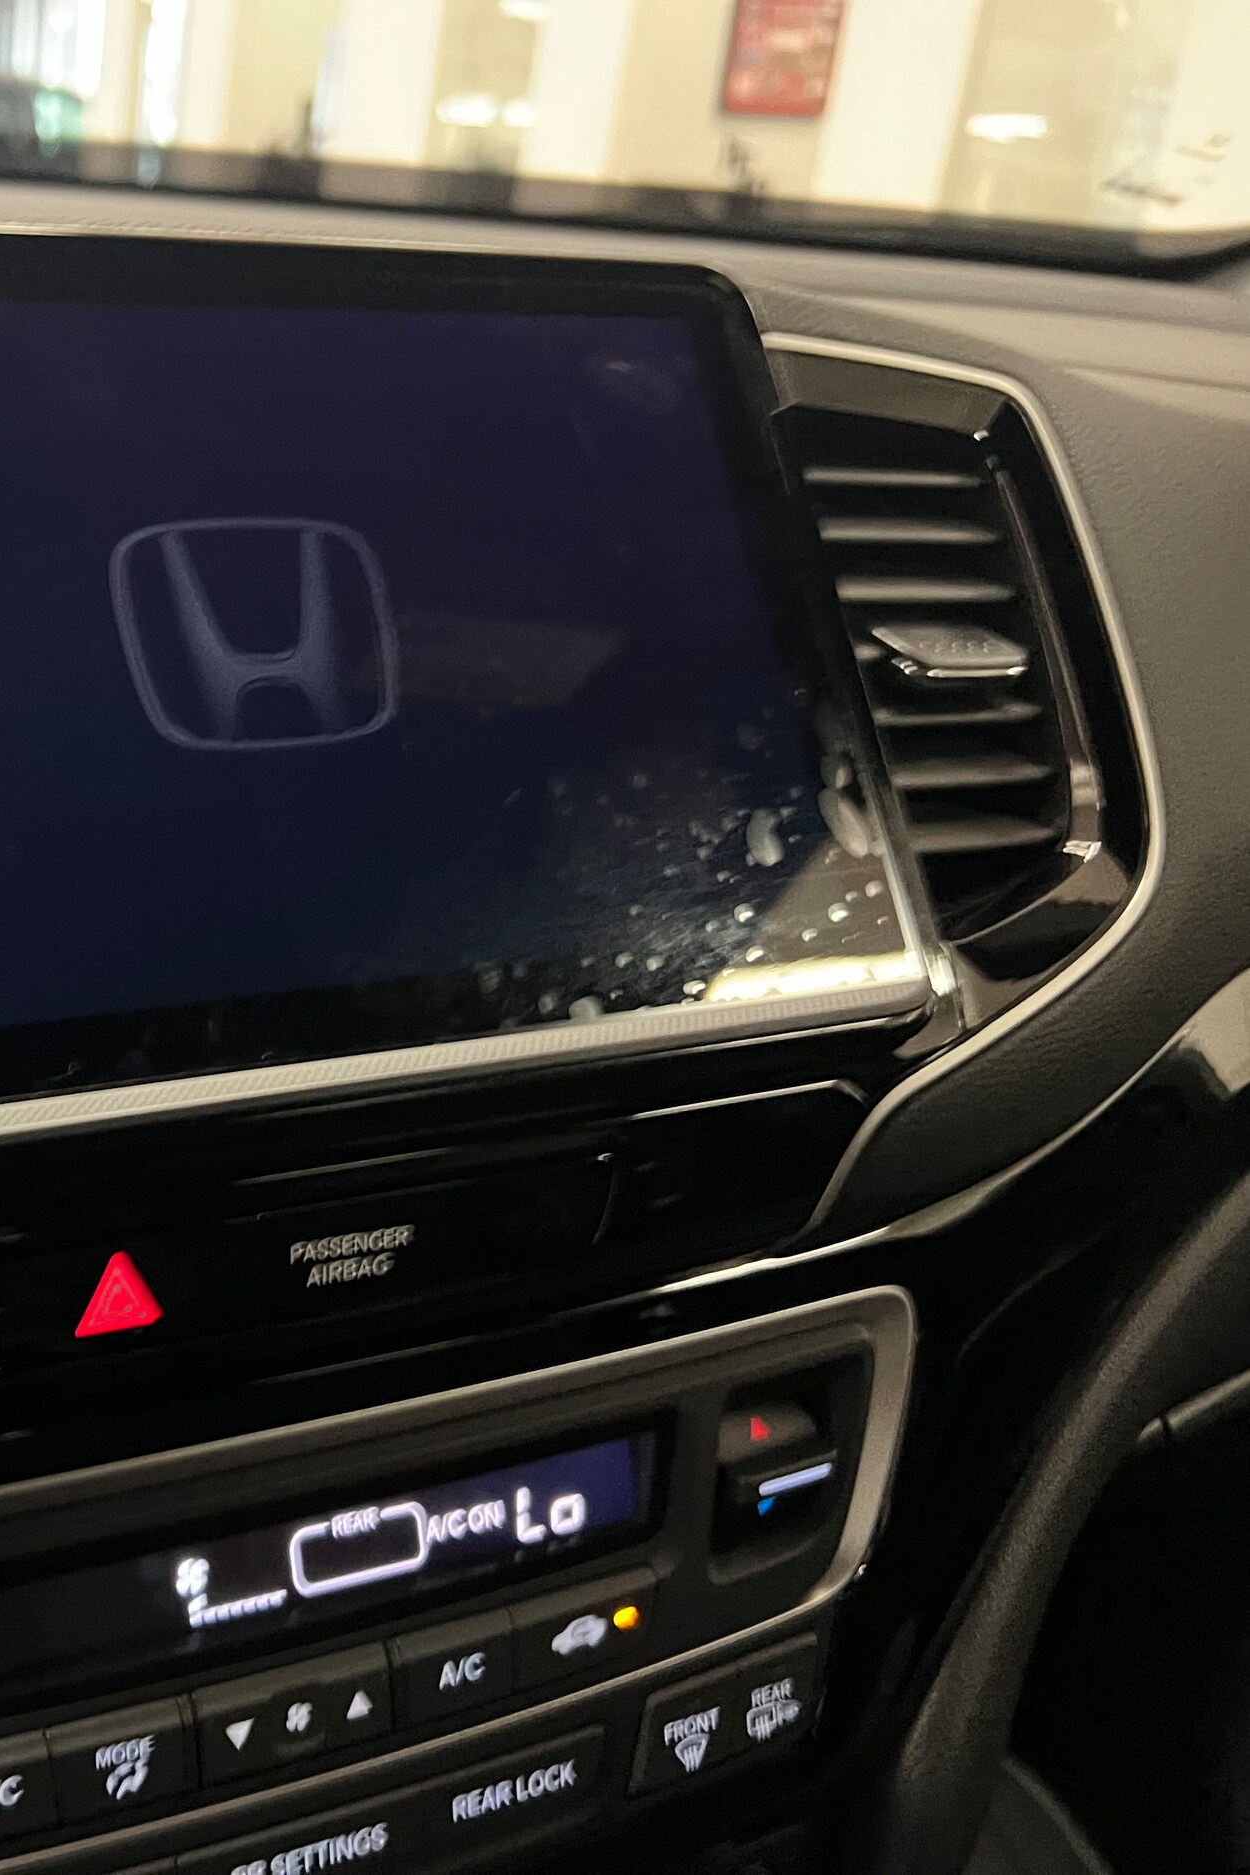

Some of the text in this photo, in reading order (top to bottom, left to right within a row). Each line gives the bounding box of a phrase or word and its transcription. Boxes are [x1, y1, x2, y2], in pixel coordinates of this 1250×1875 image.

[290, 1224, 415, 1265] PASSENGER
[306, 1251, 396, 1288] AIRBAG
[331, 1506, 380, 1539] REAR
[515, 1487, 585, 1543] Lo
[439, 1651, 485, 1690] A/C
[751, 1678, 794, 1707] REAR
[664, 1706, 721, 1746] FRONT
[95, 1734, 155, 1770] MODE
[452, 1758, 578, 1823] REAR LOCK
[270, 1822, 389, 1875] SETTINGS
